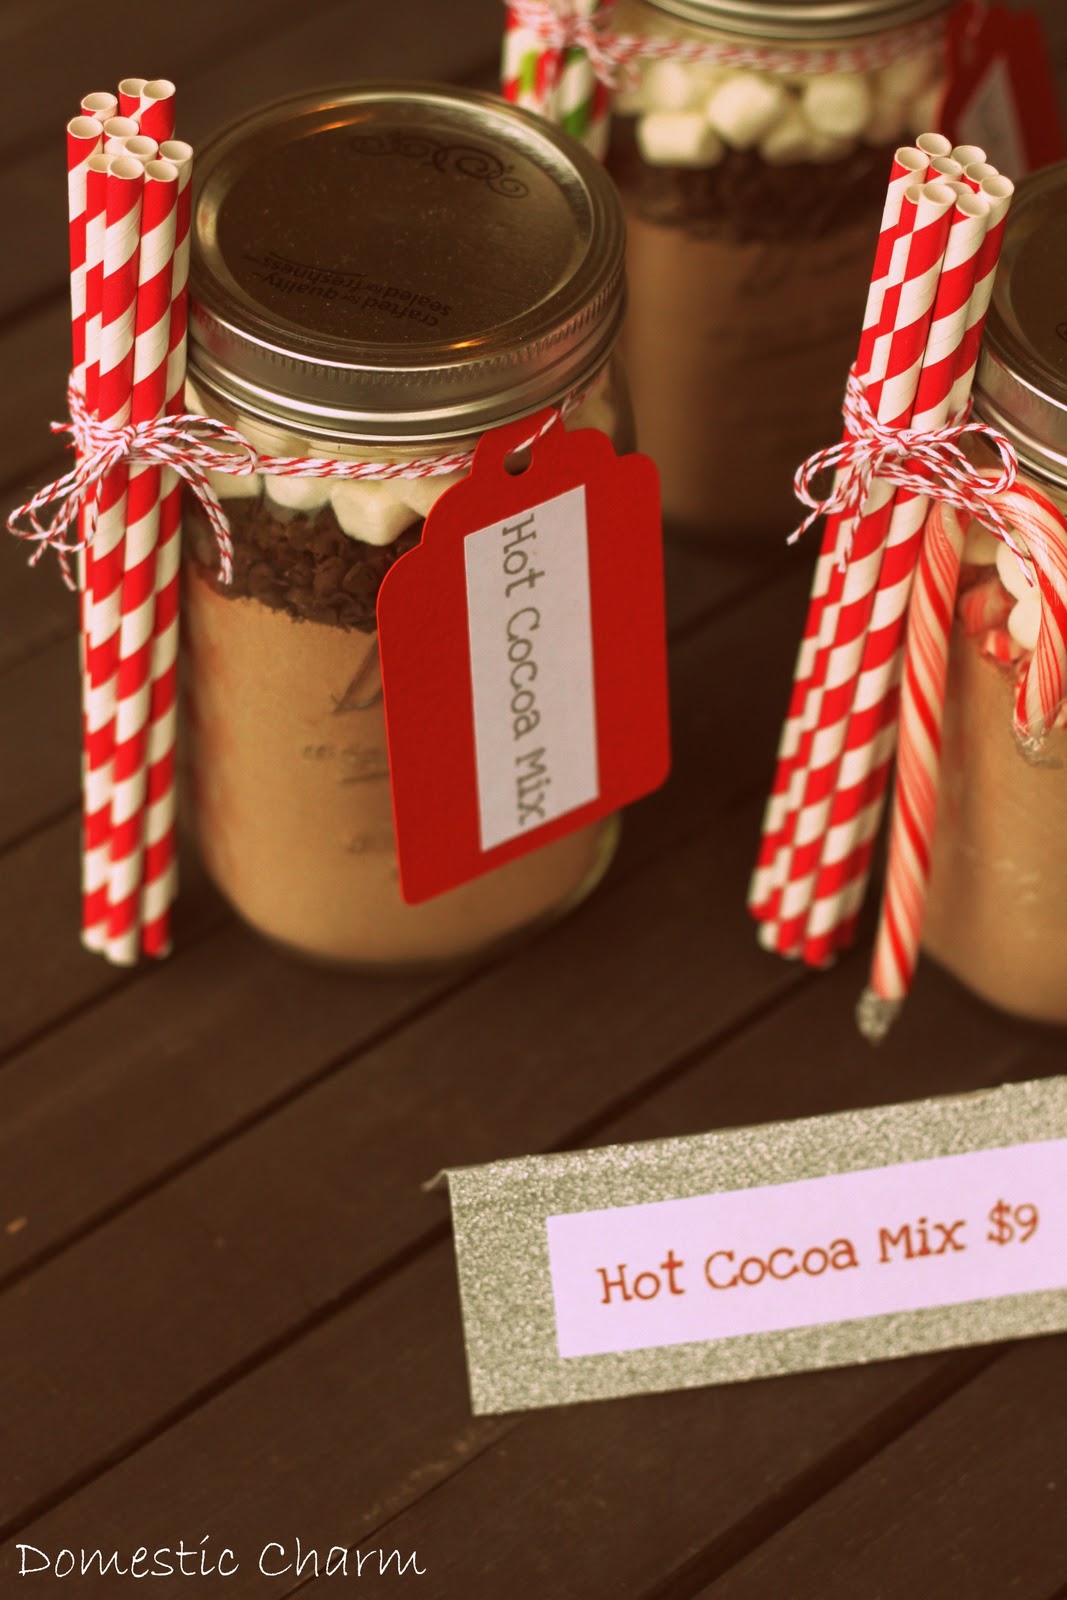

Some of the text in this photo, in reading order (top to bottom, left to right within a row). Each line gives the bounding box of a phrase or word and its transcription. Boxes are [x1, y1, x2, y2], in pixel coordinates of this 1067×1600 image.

[258, 273, 338, 301] quality
[263, 256, 362, 293] freshness
[361, 297, 439, 327] crafted
[383, 286, 453, 318] sealed
[502, 513, 552, 827] Hot Cocoa Mix
[597, 1198, 1040, 1305] Hot Cocoa Mix $9
